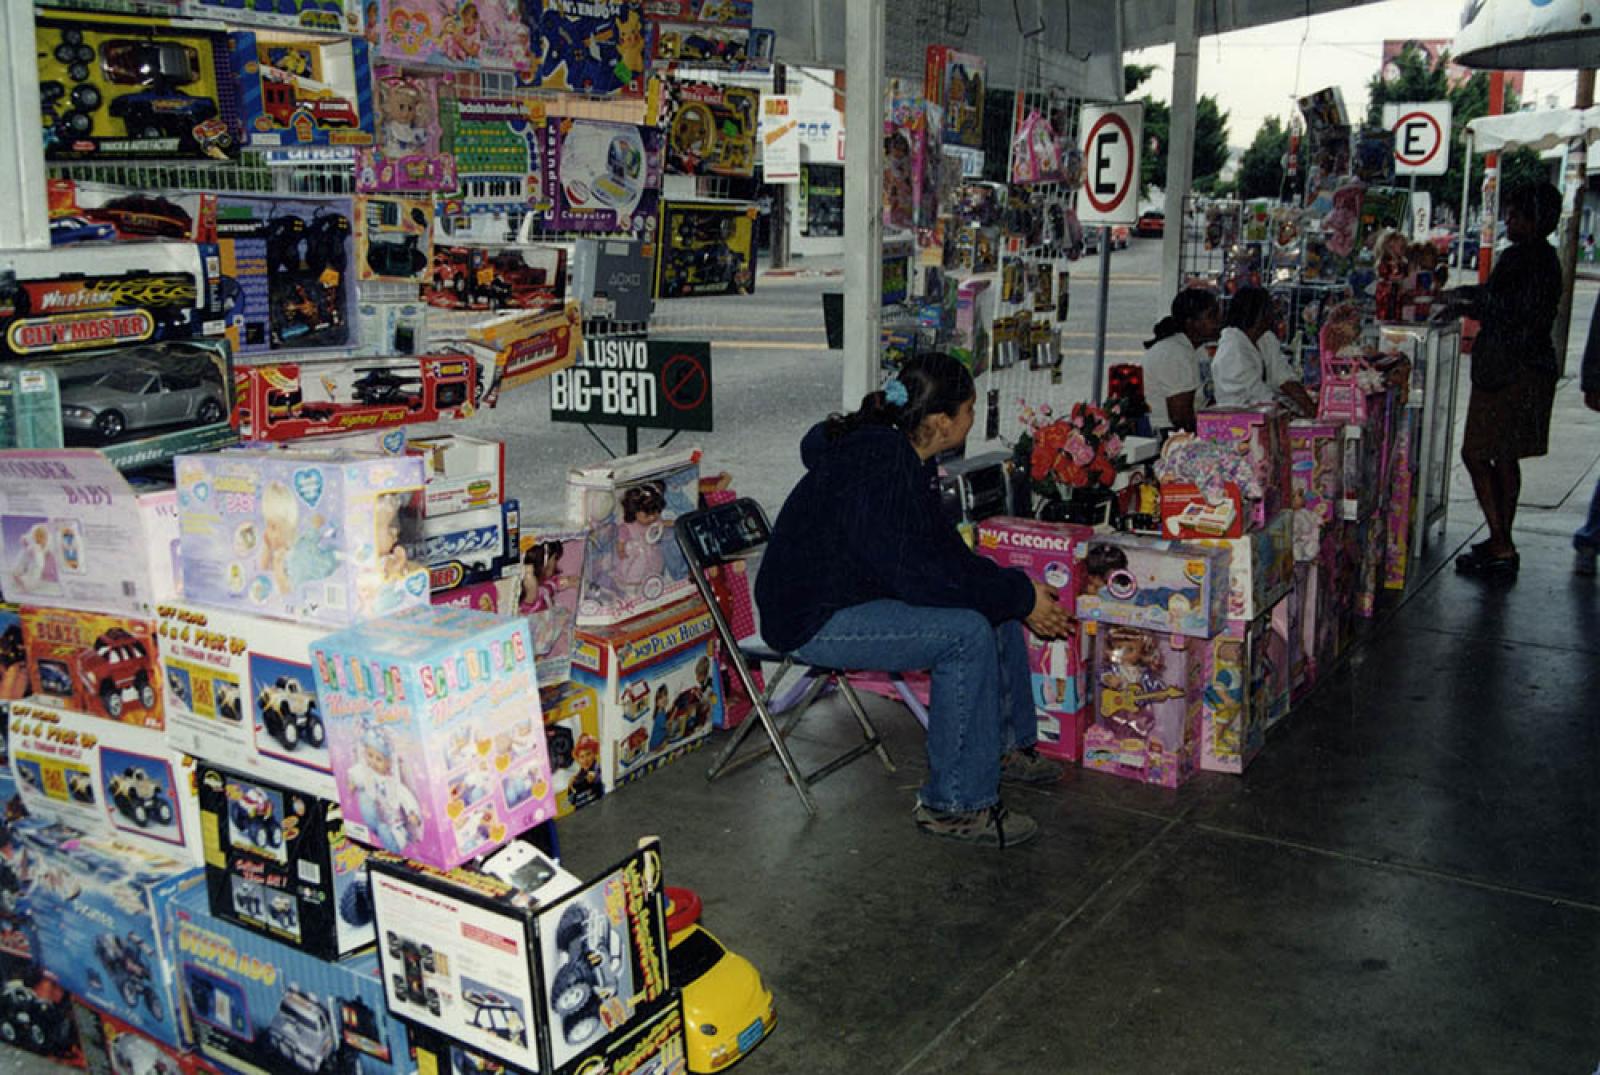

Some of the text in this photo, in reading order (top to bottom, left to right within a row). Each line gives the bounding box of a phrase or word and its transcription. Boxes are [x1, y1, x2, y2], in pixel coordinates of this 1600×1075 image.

[1404, 122, 1428, 155] E
[1095, 132, 1119, 194] E
[560, 210, 613, 220] Computer
[21, 316, 145, 347] CITY MASTER
[583, 340, 649, 369] LUSIVO
[194, 628, 228, 653] PICK
[228, 635, 247, 655] UP
[419, 648, 490, 700] SCHOOL
[489, 631, 526, 673] BAG
